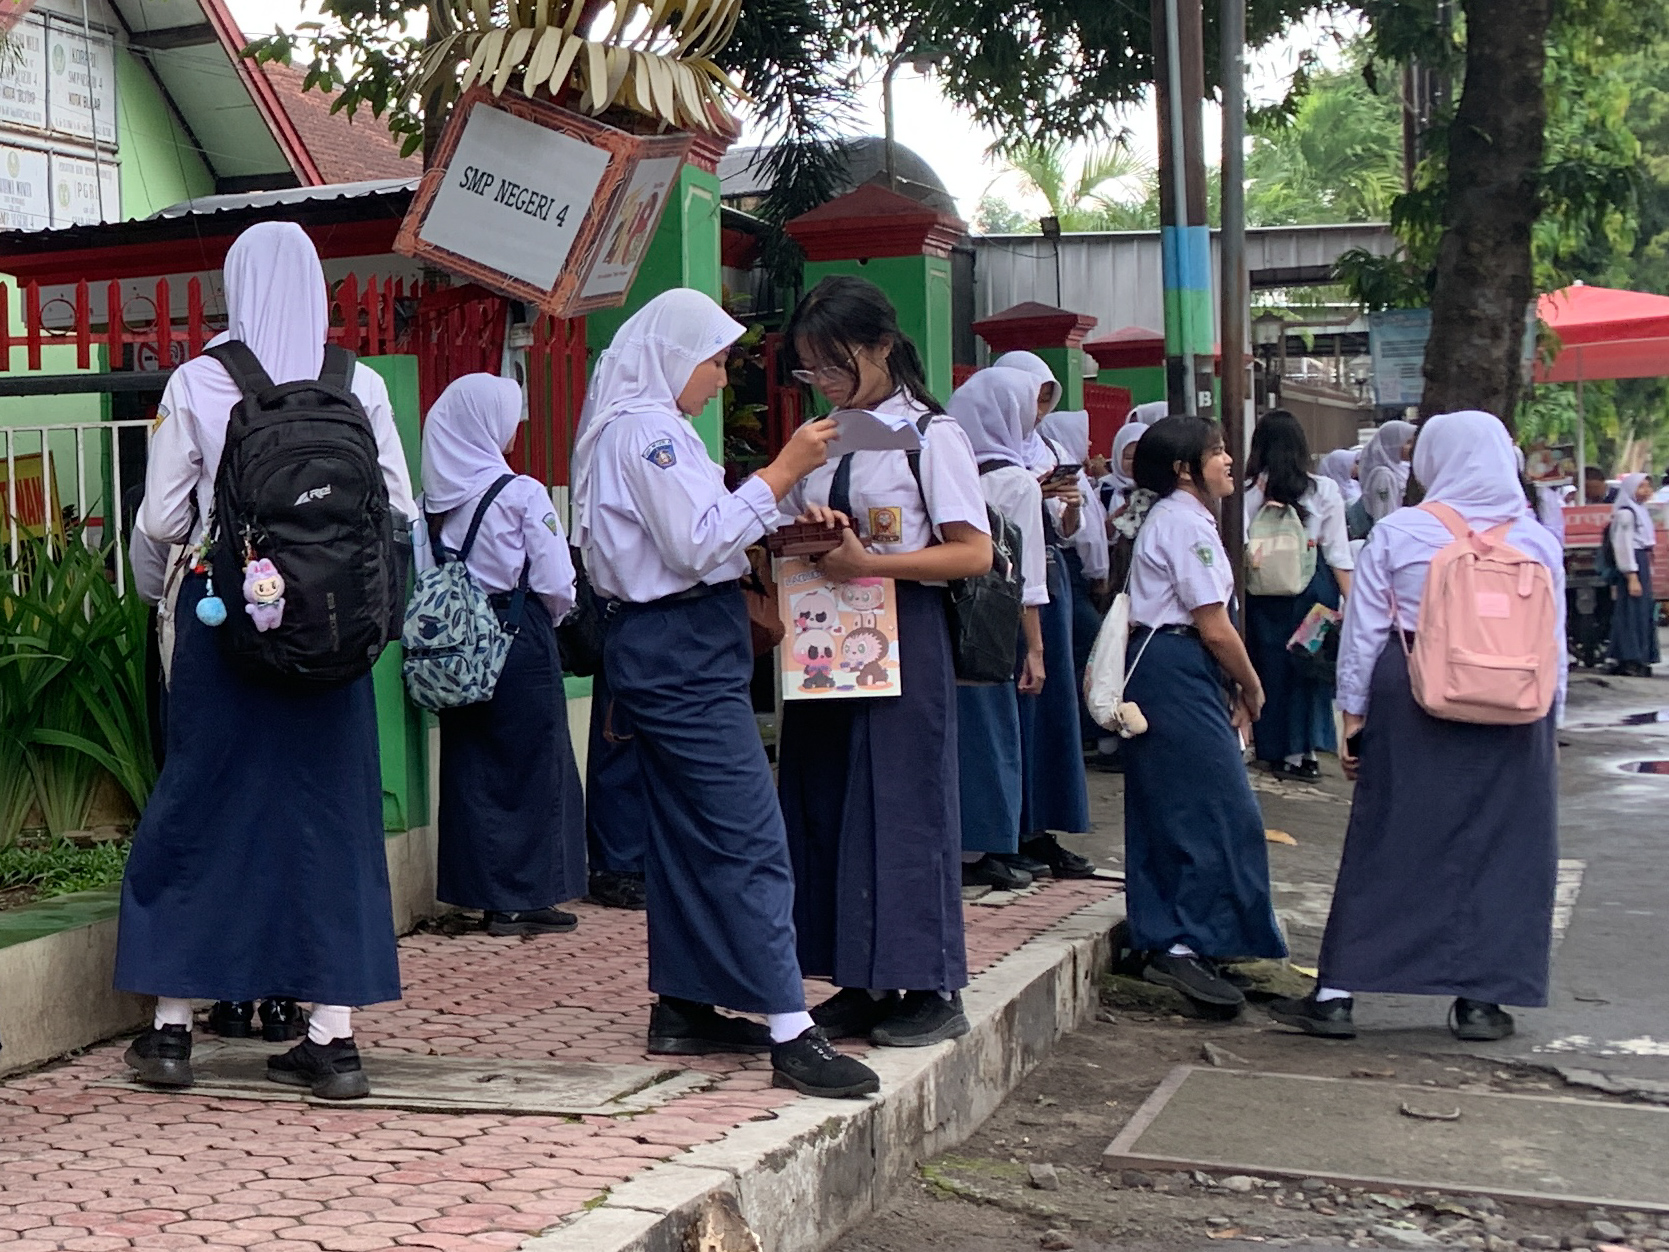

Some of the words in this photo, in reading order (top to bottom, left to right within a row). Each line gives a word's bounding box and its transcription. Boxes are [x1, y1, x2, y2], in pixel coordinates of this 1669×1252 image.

[459, 165, 495, 197] SMP
[494, 178, 555, 221] NEGERI
[555, 204, 570, 228] 4
[1198, 390, 1212, 407] B
